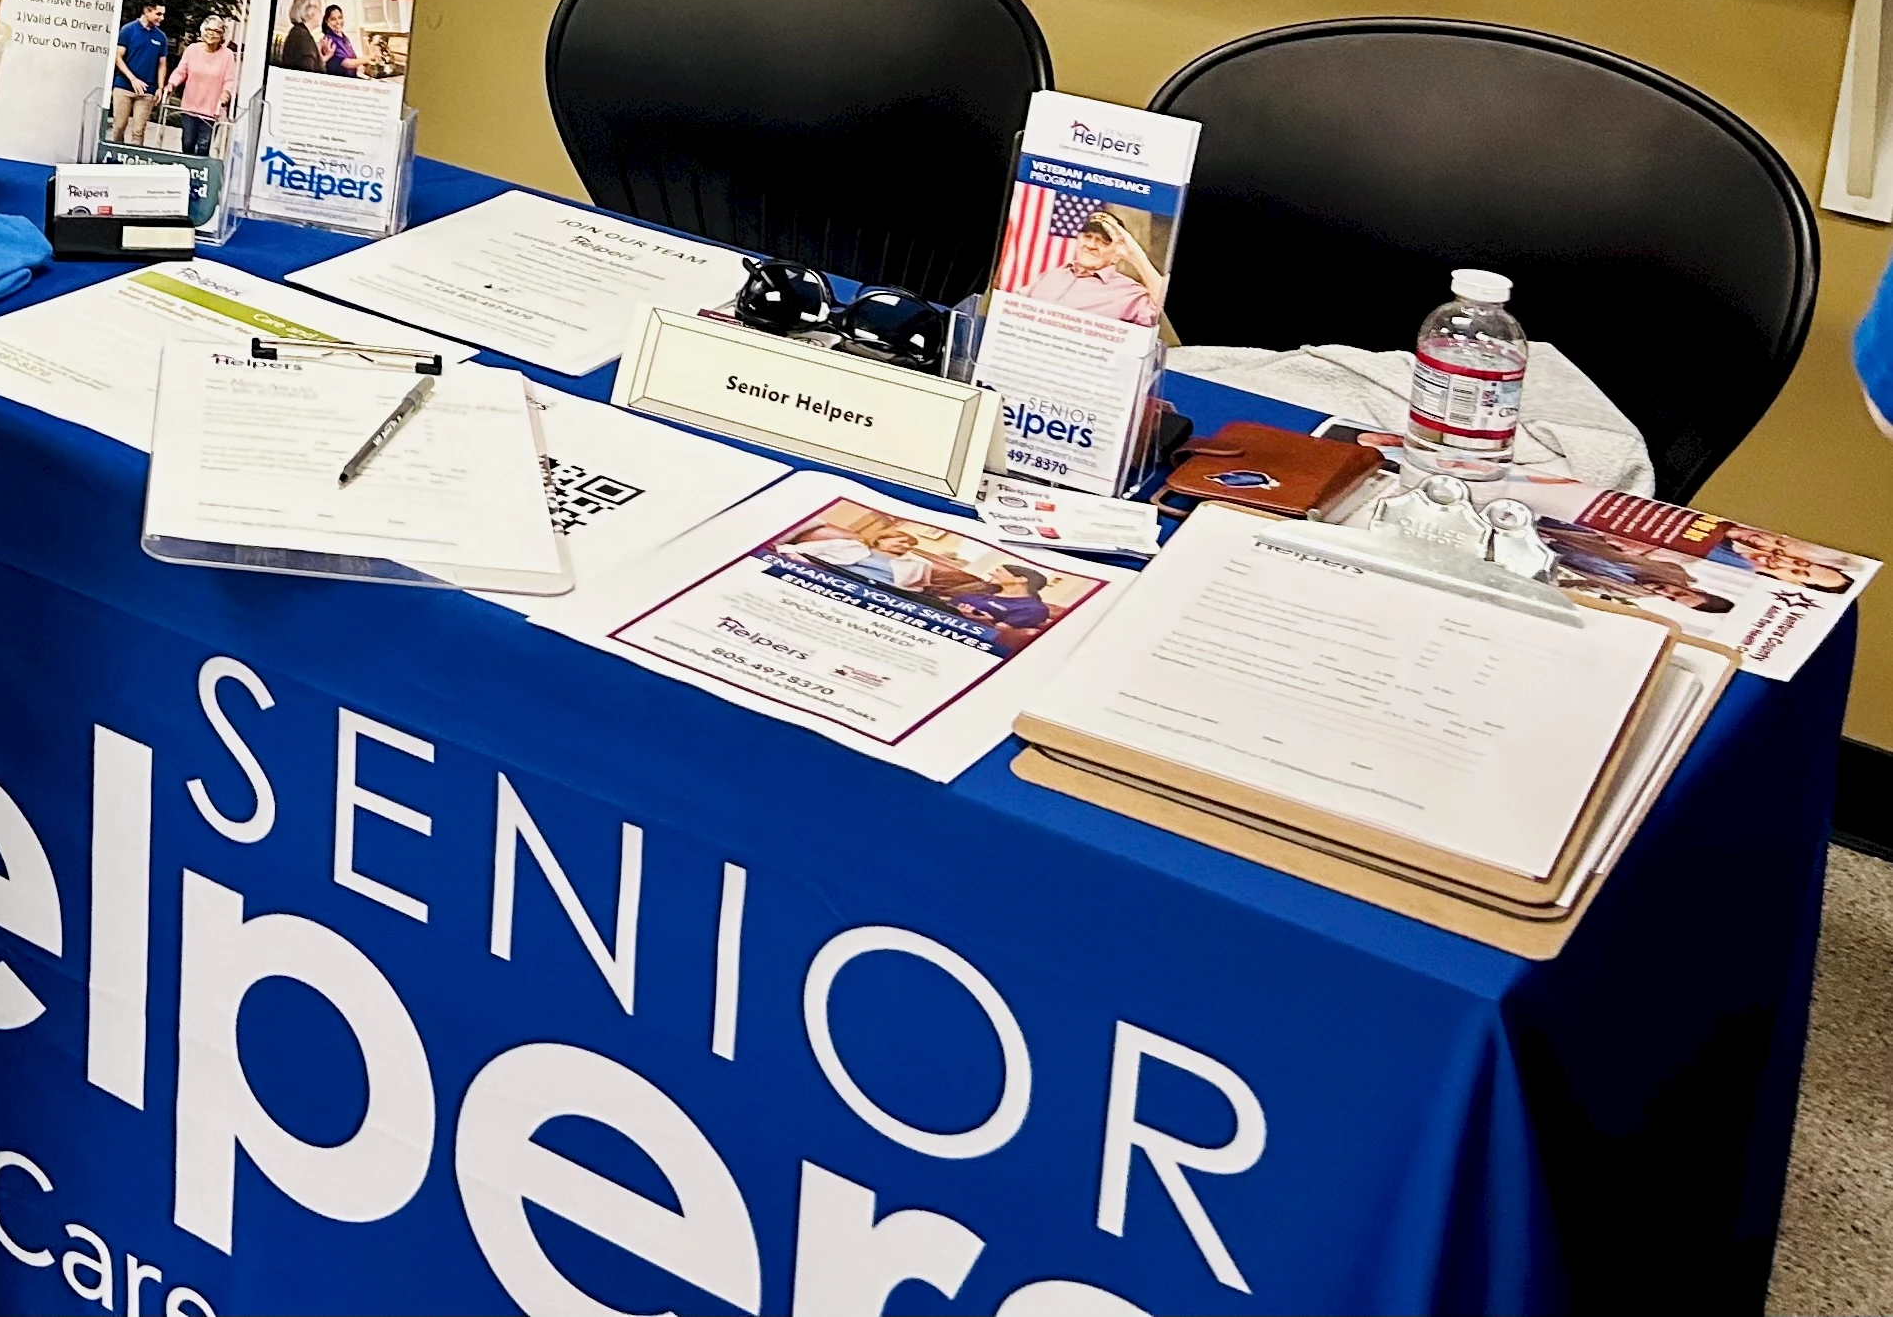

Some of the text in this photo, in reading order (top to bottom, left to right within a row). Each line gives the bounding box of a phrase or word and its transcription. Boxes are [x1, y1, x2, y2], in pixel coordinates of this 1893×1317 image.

[53, 17, 69, 28] CA
[70, 18, 104, 33] Driver
[14, 32, 110, 56] 2) Your Own Trans
[1072, 128, 1142, 156] Helpers
[68, 184, 110, 200] Helpers
[266, 160, 383, 203] Helpers
[1029, 170, 1083, 191] PROGRAM
[1031, 159, 1152, 195] VETERAN ASSISTANCE
[556, 218, 709, 266] JOIN OUR TEAM
[214, 355, 304, 372] Helpers
[725, 374, 874, 428] Senior Helpers
[1027, 396, 1098, 426] SENIOR
[1002, 401, 1094, 449] elpers
[761, 553, 986, 636] ENHANCE YOUR SKILLS
[779, 572, 994, 653] ENRICH THEIR LIVES
[780, 597, 845, 625] SPOUSES
[716, 620, 811, 662] Helpers
[870, 619, 937, 647] MILITARY
[1747, 610, 1806, 664] Ventura County
[187, 655, 1267, 1296] SENIOR
